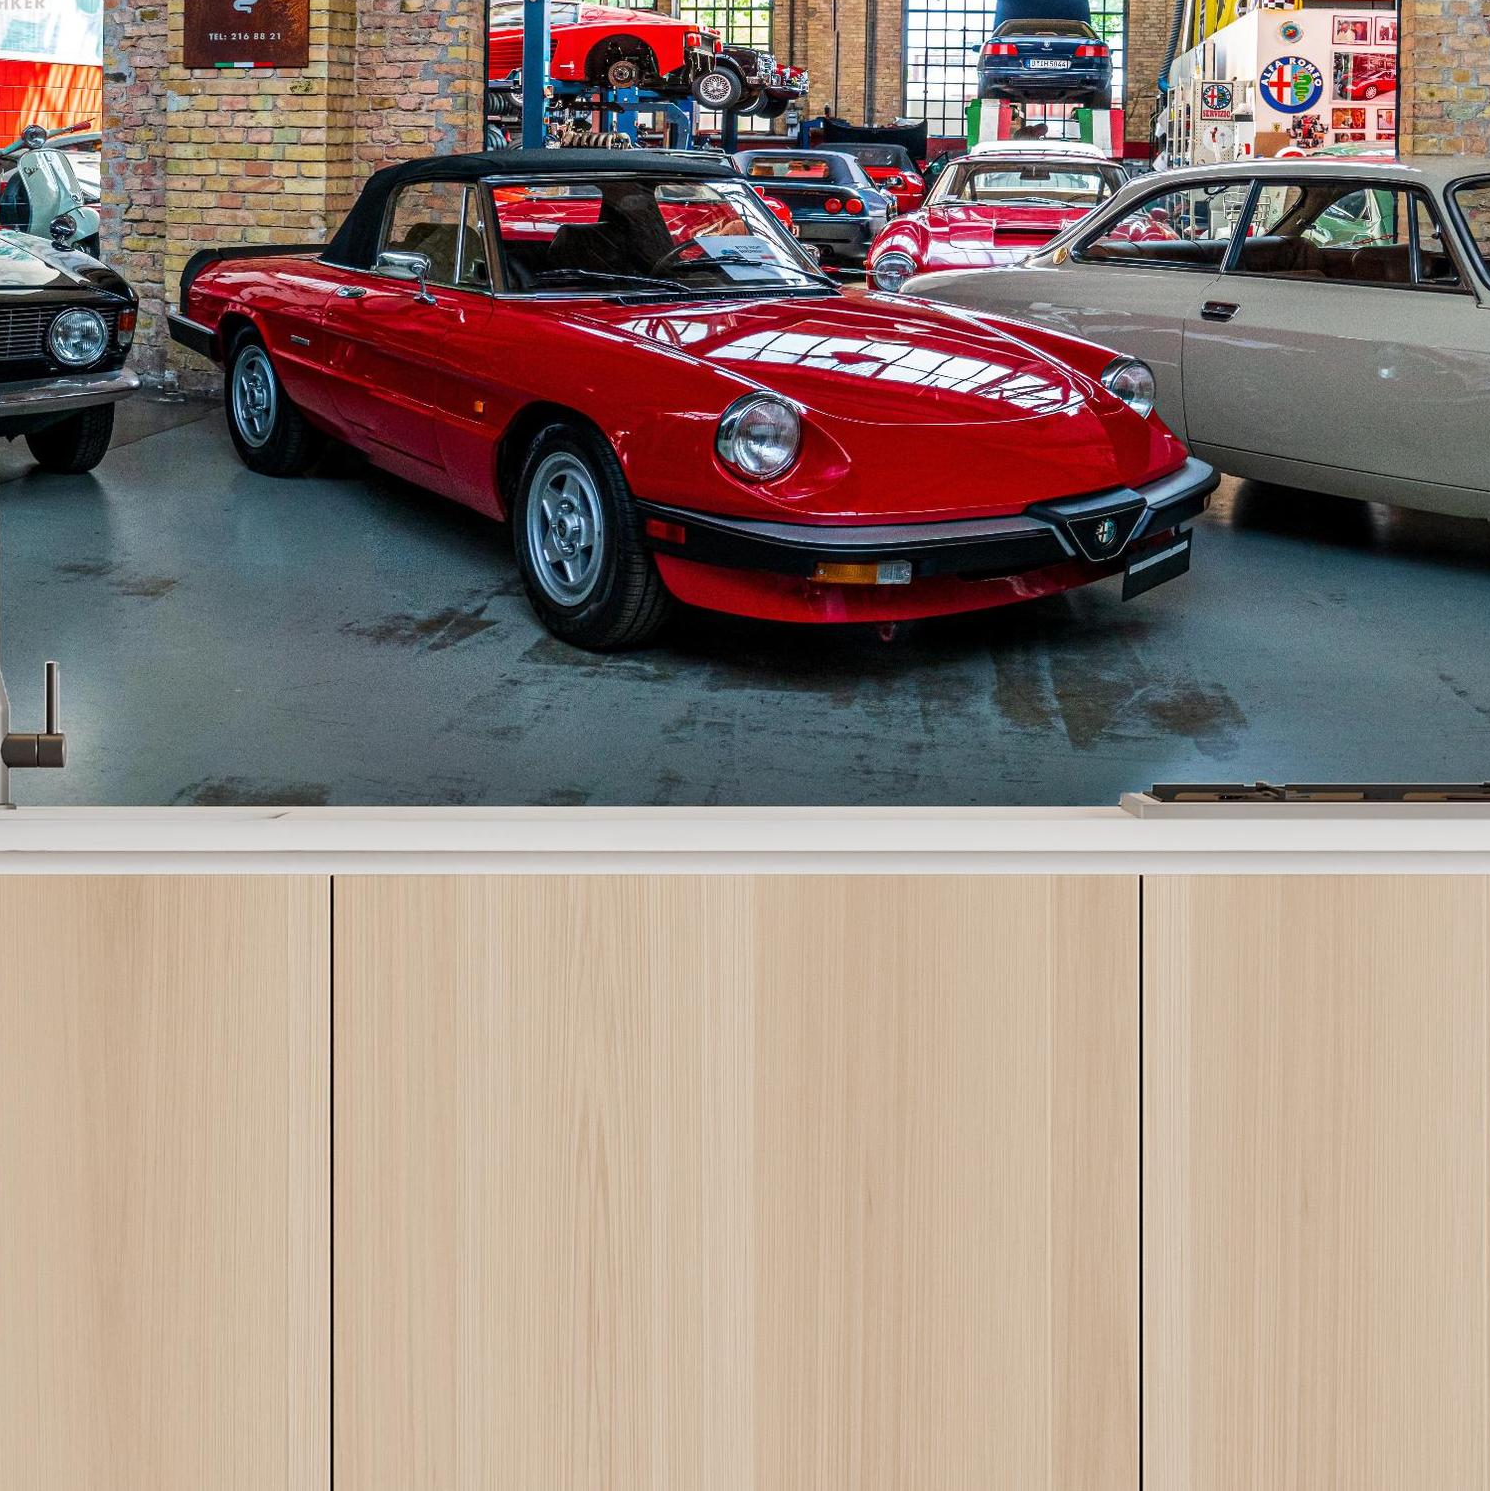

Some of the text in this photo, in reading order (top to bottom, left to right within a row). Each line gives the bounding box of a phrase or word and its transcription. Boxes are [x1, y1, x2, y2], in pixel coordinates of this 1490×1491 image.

[209, 33, 227, 41] TEL:
[1261, 57, 1322, 87] ALFA ROMEO
